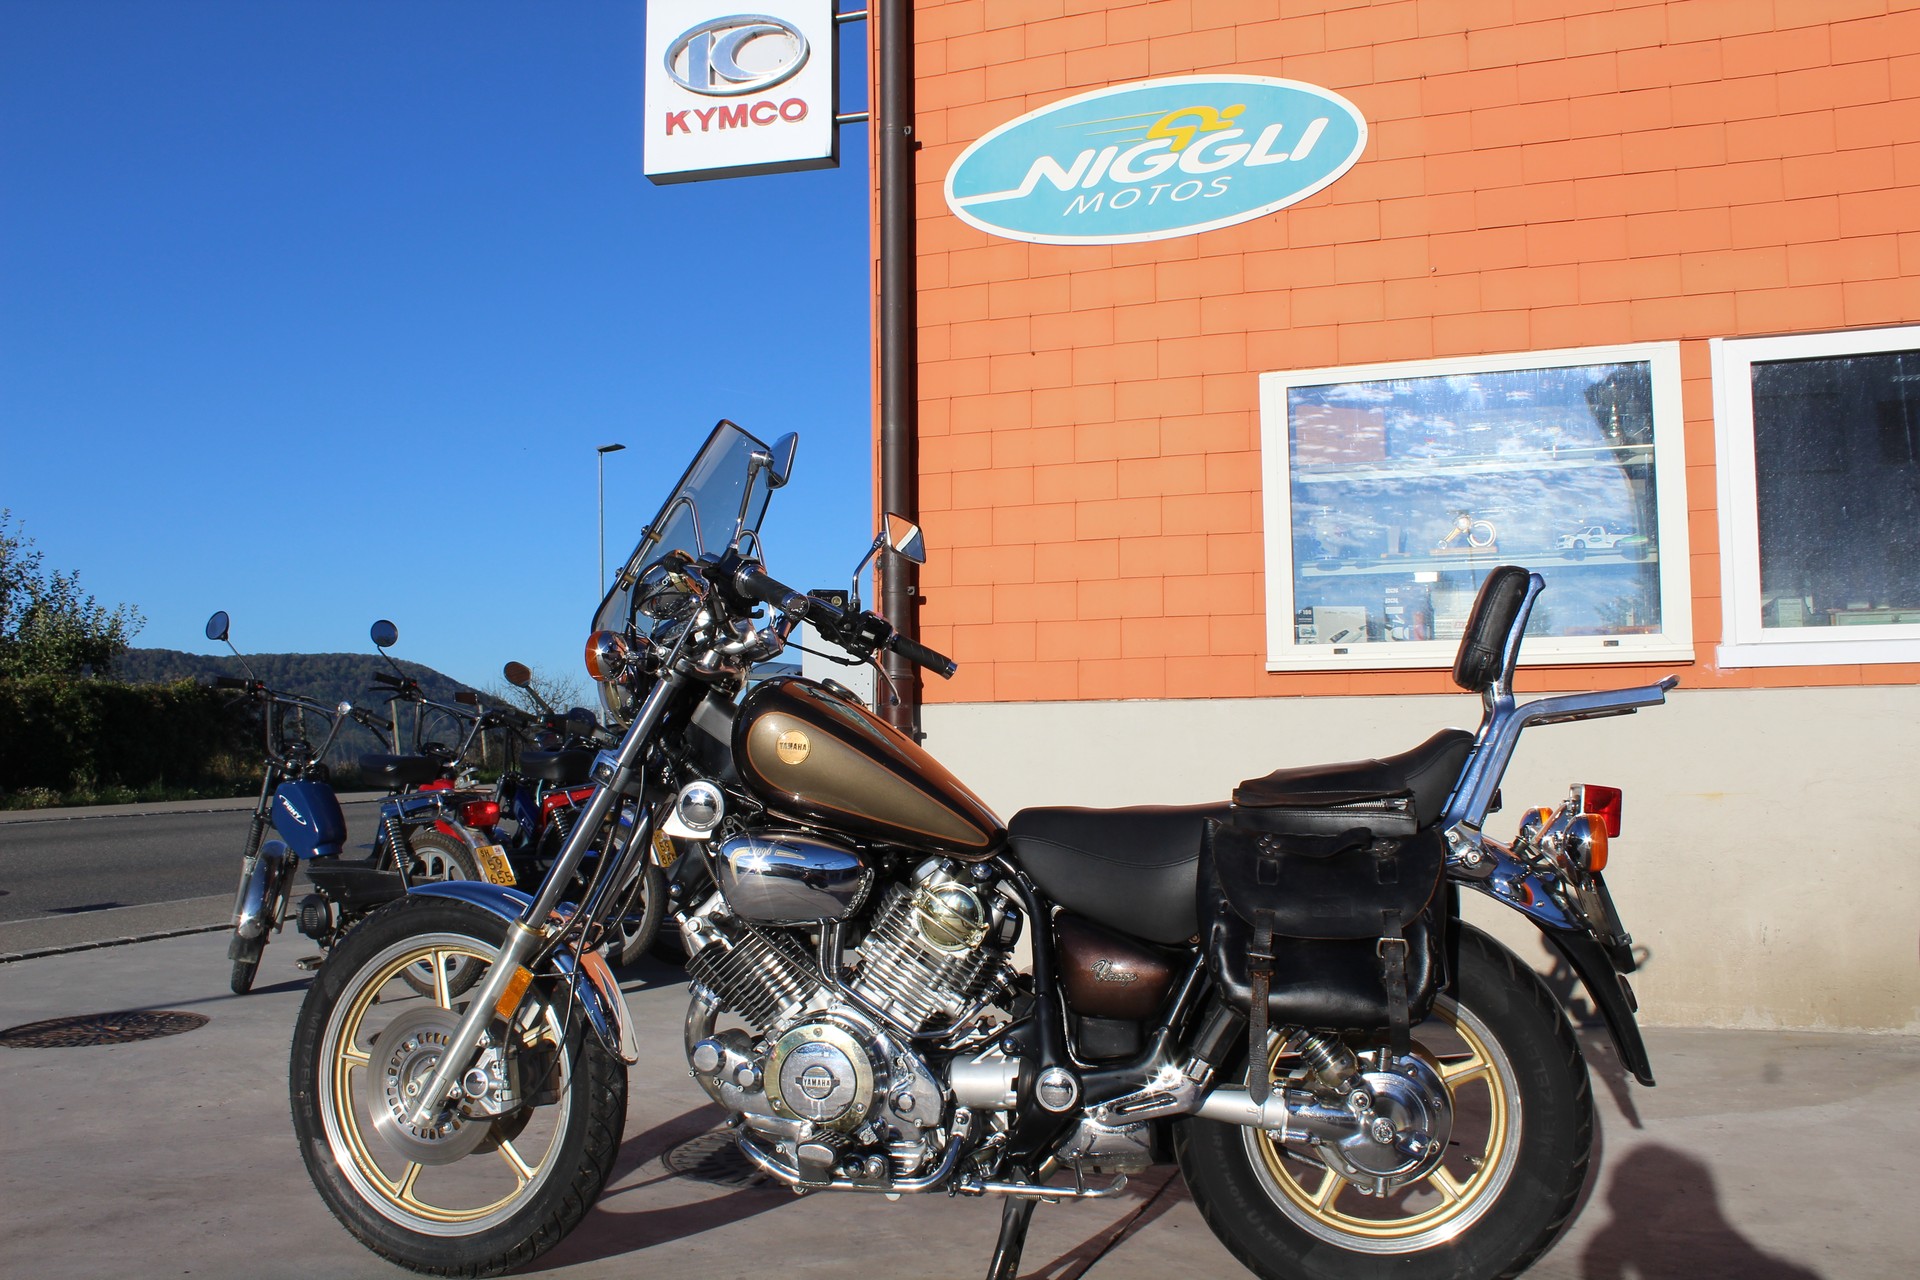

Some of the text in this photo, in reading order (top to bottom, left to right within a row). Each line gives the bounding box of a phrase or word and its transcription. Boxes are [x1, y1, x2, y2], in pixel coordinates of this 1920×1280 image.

[665, 98, 808, 135] KYMCO
[1017, 117, 1329, 197] NIGGLI
[1063, 176, 1232, 217] MOTOS
[779, 742, 807, 751] YAMAHA
[480, 849, 489, 858] SH
[486, 855, 503, 870] 59
[490, 870, 513, 885] 655
[803, 1078, 831, 1087] YAMAHA
